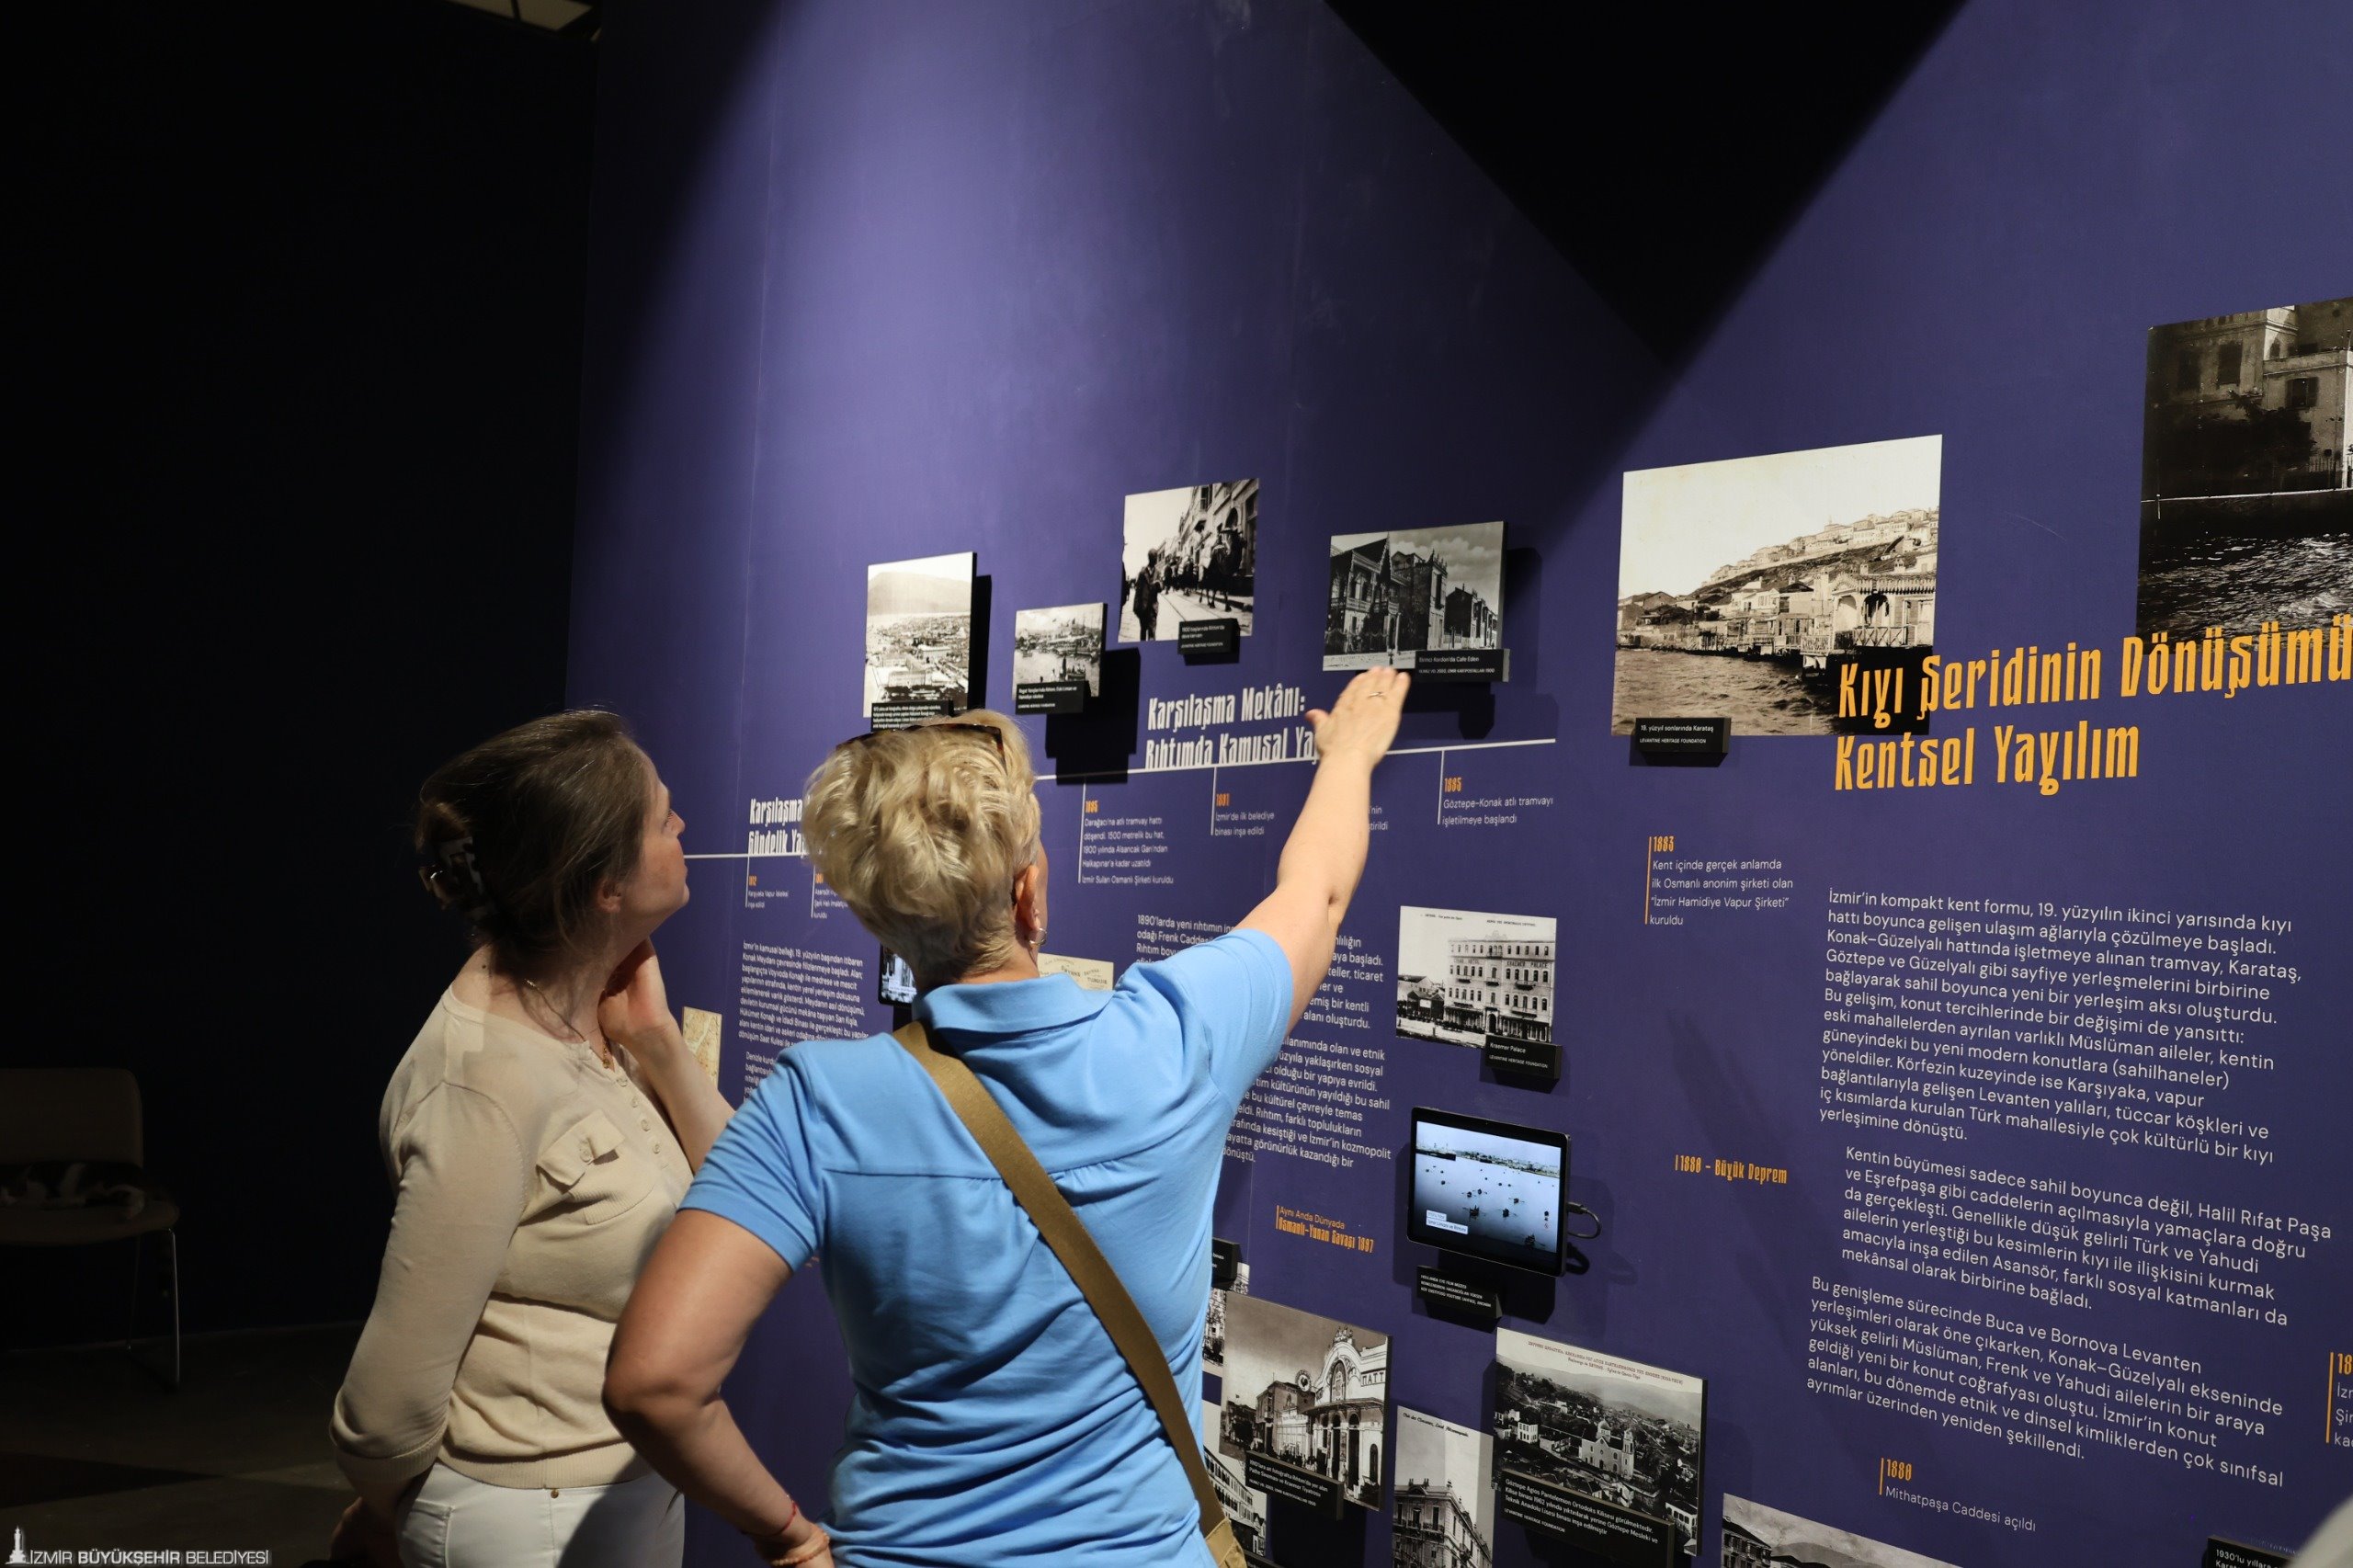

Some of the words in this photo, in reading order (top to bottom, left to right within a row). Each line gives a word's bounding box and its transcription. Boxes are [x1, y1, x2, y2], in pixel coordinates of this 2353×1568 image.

[1839, 664, 1903, 728] Kıyı
[1916, 642, 2101, 721] Şeridinin
[1148, 694, 1235, 732] Karşılaşma
[1242, 683, 1305, 722] Mekânı:
[1145, 735, 1213, 768] Rıhtımda
[1219, 728, 1288, 765] Kamusal
[1836, 727, 1974, 790] Kentsel
[1995, 721, 2138, 794] Yayılım
[750, 797, 802, 827] Karşılaşma
[1442, 814, 1483, 828] işletilmeye
[1483, 813, 1517, 826] başlandı
[1504, 796, 1517, 807] atlı
[1518, 797, 1553, 807] tramvayı
[748, 829, 788, 856] Gündelik
[1652, 878, 1661, 888] ilk
[1664, 878, 1700, 889] Osmanlı
[1702, 877, 1738, 889] anonim
[1740, 878, 1769, 892] şirketi
[1772, 877, 1793, 889] olan
[1653, 859, 1673, 870] Kent
[1676, 859, 1703, 873] içinde
[1705, 858, 1737, 873] gerçek
[1740, 858, 1782, 869] anlamda
[1649, 914, 1683, 926] kuruldu
[1677, 896, 1721, 910] Hamidiye
[1723, 896, 1752, 910] Vapur
[1881, 892, 1944, 912] kompakt
[1948, 896, 1980, 912] kent
[1984, 899, 2033, 917] formu,
[2038, 903, 2057, 917] 19.
[2062, 904, 2122, 924] yüzyılın
[2128, 908, 2170, 925] ikinci
[2176, 914, 2256, 930] yarısında
[2261, 915, 2290, 936] kıyı
[1828, 909, 1859, 924] hattı
[1863, 911, 1925, 930] boyunca
[1928, 917, 1981, 937] gelişen
[1985, 921, 2035, 940] ulaşım
[2039, 925, 2106, 945] ağlarıyla
[2111, 929, 2202, 952] çözülmeye
[2208, 935, 2276, 956] başladı.
[1946, 937, 2009, 956] hattında
[2014, 943, 2091, 965] işletmeye
[2096, 949, 2144, 967] alınan
[2149, 954, 2222, 976] tramvay,
[2229, 960, 2301, 983] Karataş,
[1304, 1054, 1353, 1072] yaklaşırken
[1354, 1063, 1383, 1077] sosyal
[1329, 1042, 1348, 1055] olan
[1349, 1047, 1361, 1057] ve
[1362, 1048, 1385, 1061] etnik
[1273, 1064, 1302, 1081] olduğu
[1303, 1068, 1316, 1081] bir
[1316, 1074, 1347, 1088] yapıya
[1347, 1079, 1377, 1092] evrildi.
[1715, 1159, 1745, 1181] Büyük
[1748, 1163, 1788, 1185] Deprem
[1846, 1145, 1890, 1165] Kentin
[1893, 1153, 1965, 1178] büyümesi
[1969, 1169, 2026, 1187] sadece
[2029, 1177, 2066, 1195] sahil
[2071, 1181, 2143, 1208] boyunca
[2147, 1195, 2192, 1218] değil,
[2199, 1202, 2234, 1222] Halil
[2241, 1209, 2282, 1231] Rıfat
[2288, 1217, 2331, 1239] Paşa
[1844, 1187, 1861, 1201] da
[1865, 1192, 1948, 1219] gerçekleşti.
[1951, 1205, 2027, 1231] Genellikle
[2030, 1219, 2079, 1241] düşük
[2083, 1231, 2127, 1249] gelirli
[2132, 1236, 2168, 1257] Türk
[2174, 1247, 2193, 1261] ve
[2199, 1248, 2258, 1274] Yahudi
[1845, 1169, 1861, 1181] ve
[1865, 1169, 1935, 1197] Eşrefpaşa
[1938, 1183, 1966, 1199] gibi
[1970, 1190, 2052, 1214] caddelerin
[2058, 1205, 2149, 1231] açılmasıyla
[2154, 1221, 2245, 1247] yamaçlara
[2251, 1235, 2305, 1258] doğru
[1812, 1276, 1828, 1291] Bu
[1832, 1283, 1904, 1308] genişleme
[1907, 1299, 1982, 1325] sürecinde
[1985, 1312, 2024, 1335] Buca
[2029, 1325, 2046, 1339] ve
[2051, 1327, 2118, 1356] Bornova
[2123, 1343, 2200, 1374] Levanten
[1811, 1298, 1891, 1326] yerleşimleri
[1894, 1316, 1938, 1337] olarak
[1943, 1325, 1971, 1344] öne
[1975, 1335, 2043, 1363] çıkarken,
[2190, 1382, 2282, 1415] ekseninde
[1885, 1486, 1949, 1513] Mithatpaşa
[1952, 1501, 2000, 1523] Caddesi
[2004, 1516, 2036, 1531] açıldı
